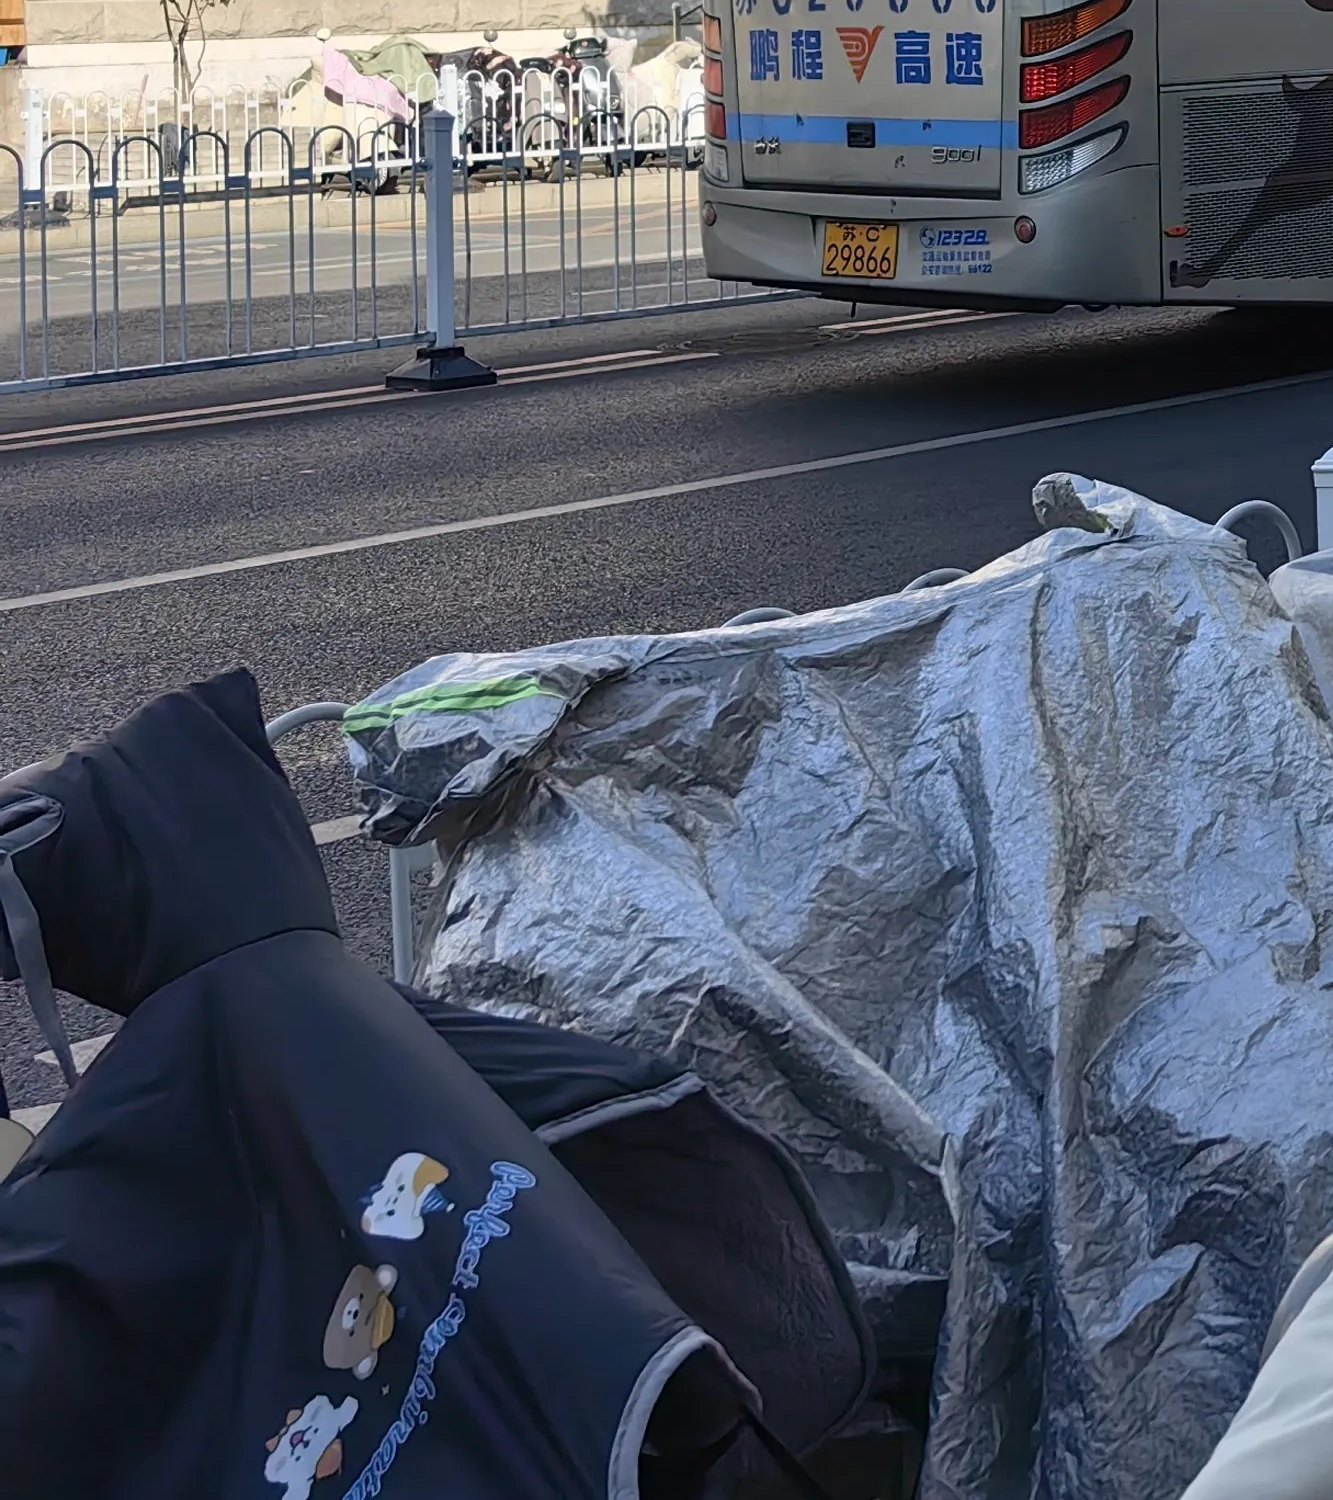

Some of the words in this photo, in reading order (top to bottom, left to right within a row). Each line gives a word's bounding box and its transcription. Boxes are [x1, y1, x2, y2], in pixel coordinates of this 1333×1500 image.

[749, 28, 824, 82] 鹏程
[894, 30, 984, 86] 高速
[826, 243, 892, 274] 29866
[452, 1160, 536, 1289] Perfect
